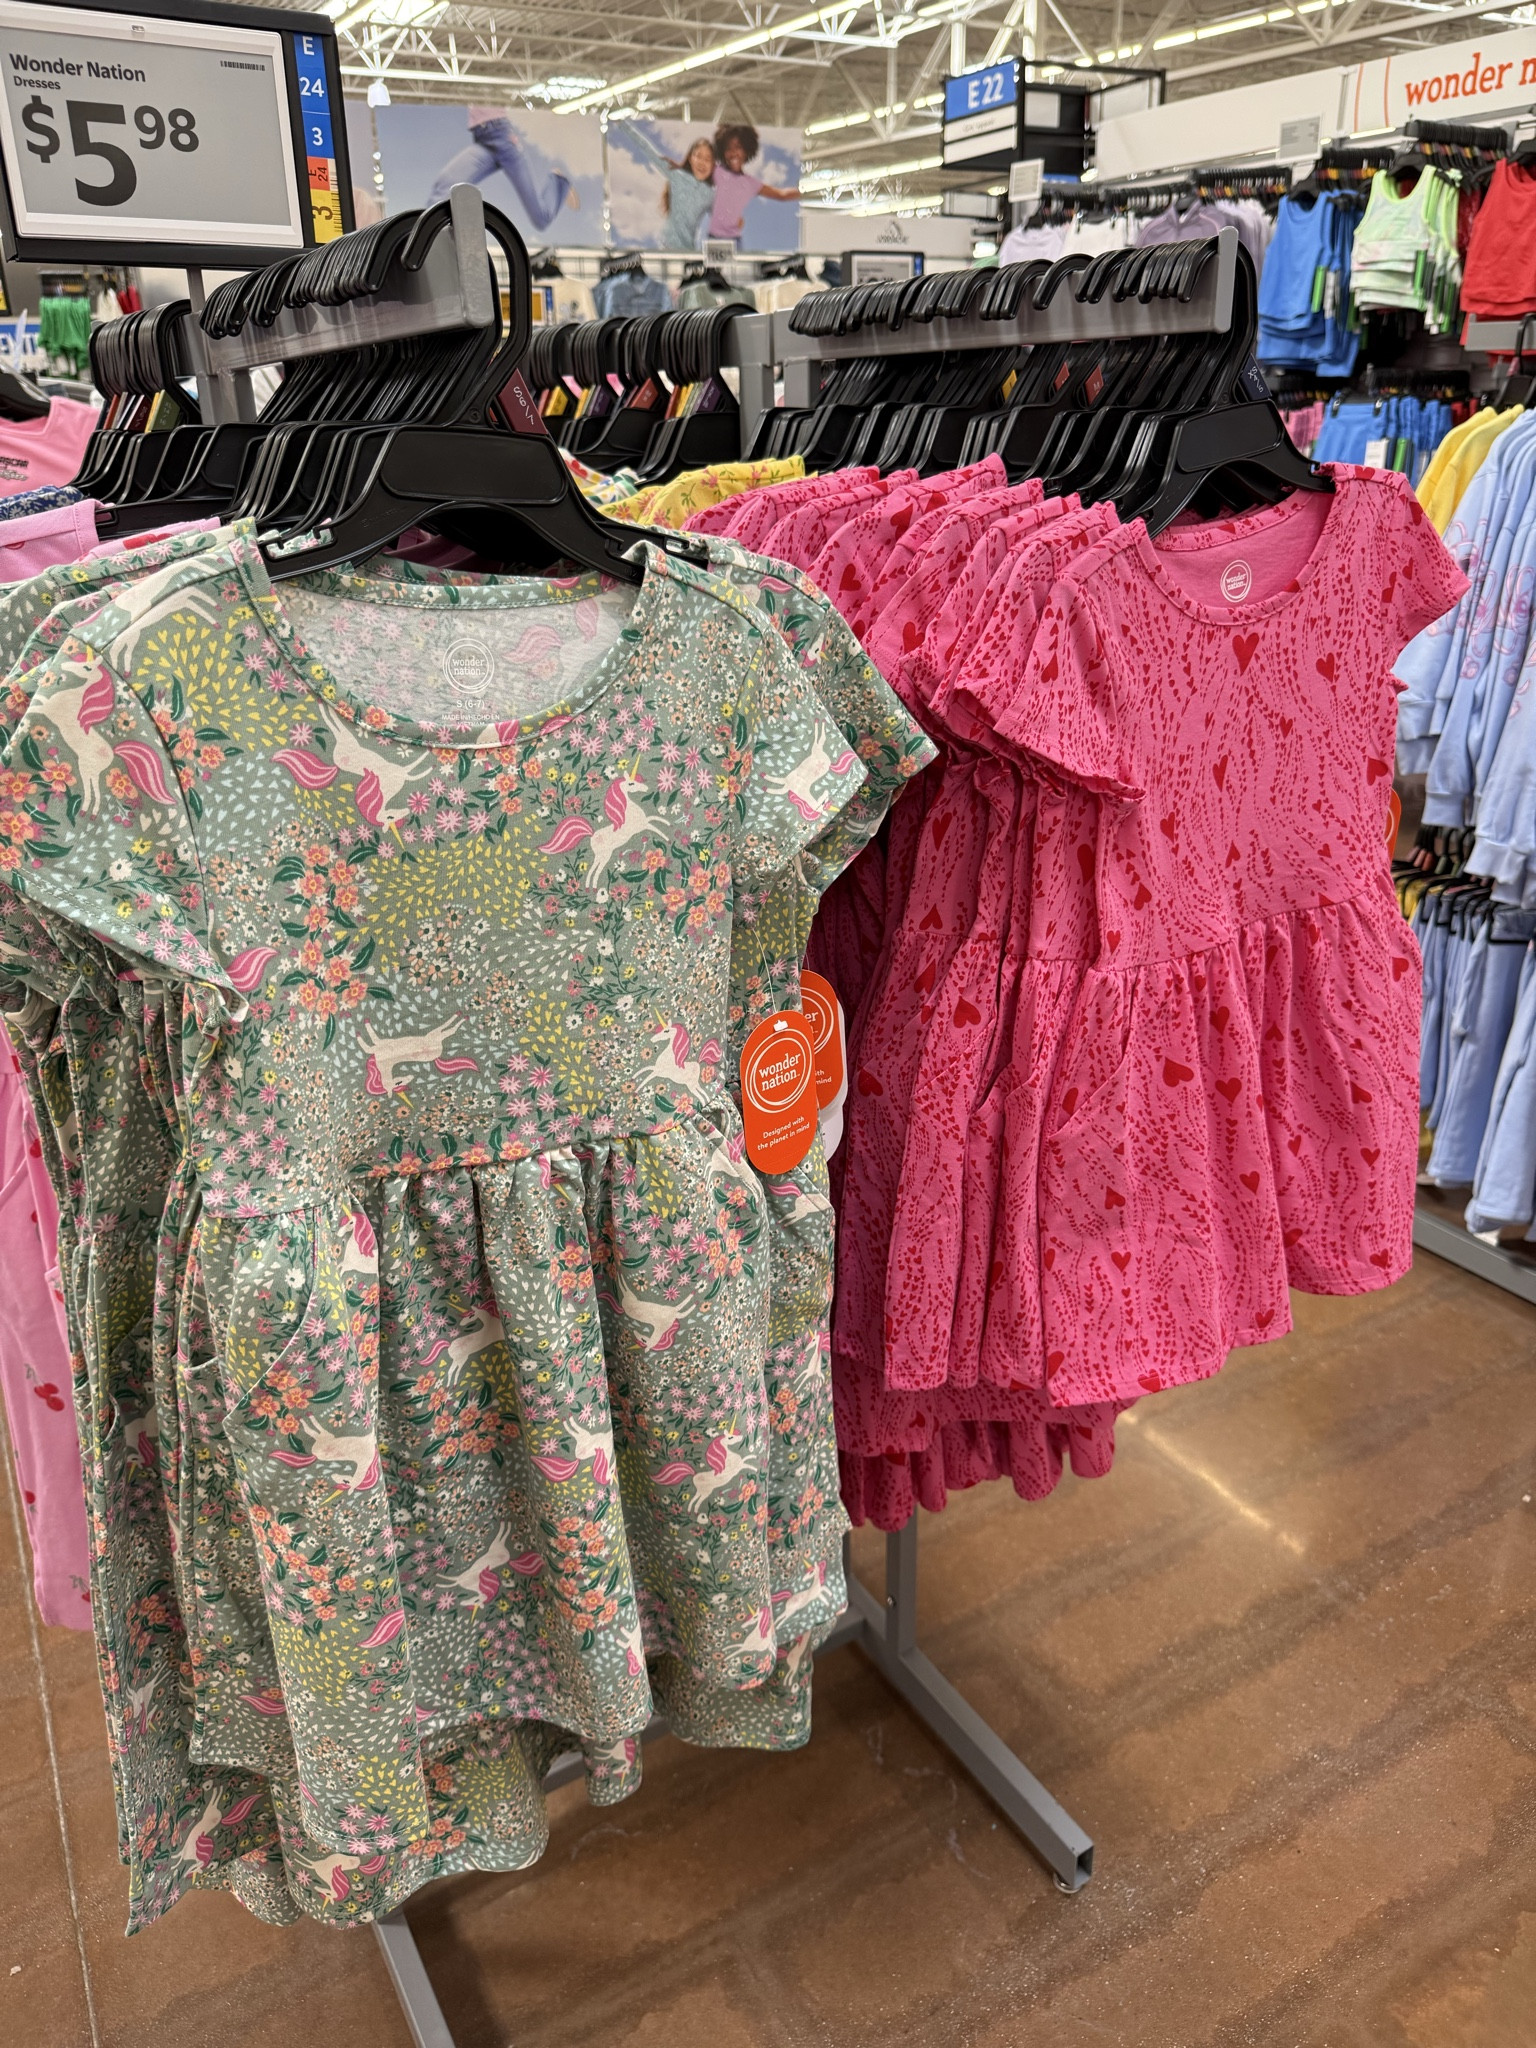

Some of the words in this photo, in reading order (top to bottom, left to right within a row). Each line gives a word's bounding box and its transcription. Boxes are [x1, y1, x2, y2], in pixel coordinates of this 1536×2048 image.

[302, 35, 315, 56] E
[9, 53, 83, 76] Wonder
[86, 61, 146, 82] Nation
[13, 75, 61, 90] Dresses
[300, 77, 325, 97] 24
[1405, 51, 1513, 107] wonder
[968, 80, 980, 109] E
[982, 73, 1004, 105] 22
[312, 127, 323, 146] 3
[317, 167, 328, 182] 24
[1226, 572, 1247, 584] wonder
[452, 655, 484, 666] wonder
[454, 666, 481, 676] nation
[456, 699, 463, 708] S
[465, 699, 485, 710] (6-7)
[759, 1053, 801, 1079] wonder
[761, 1069, 797, 1092] nation
[757, 1141, 768, 1151] the
[769, 1133, 789, 1148] planet
[790, 1130, 796, 1138] in
[796, 1122, 810, 1134] mind
[763, 1121, 792, 1139] Designed
[792, 1116, 805, 1126] with
